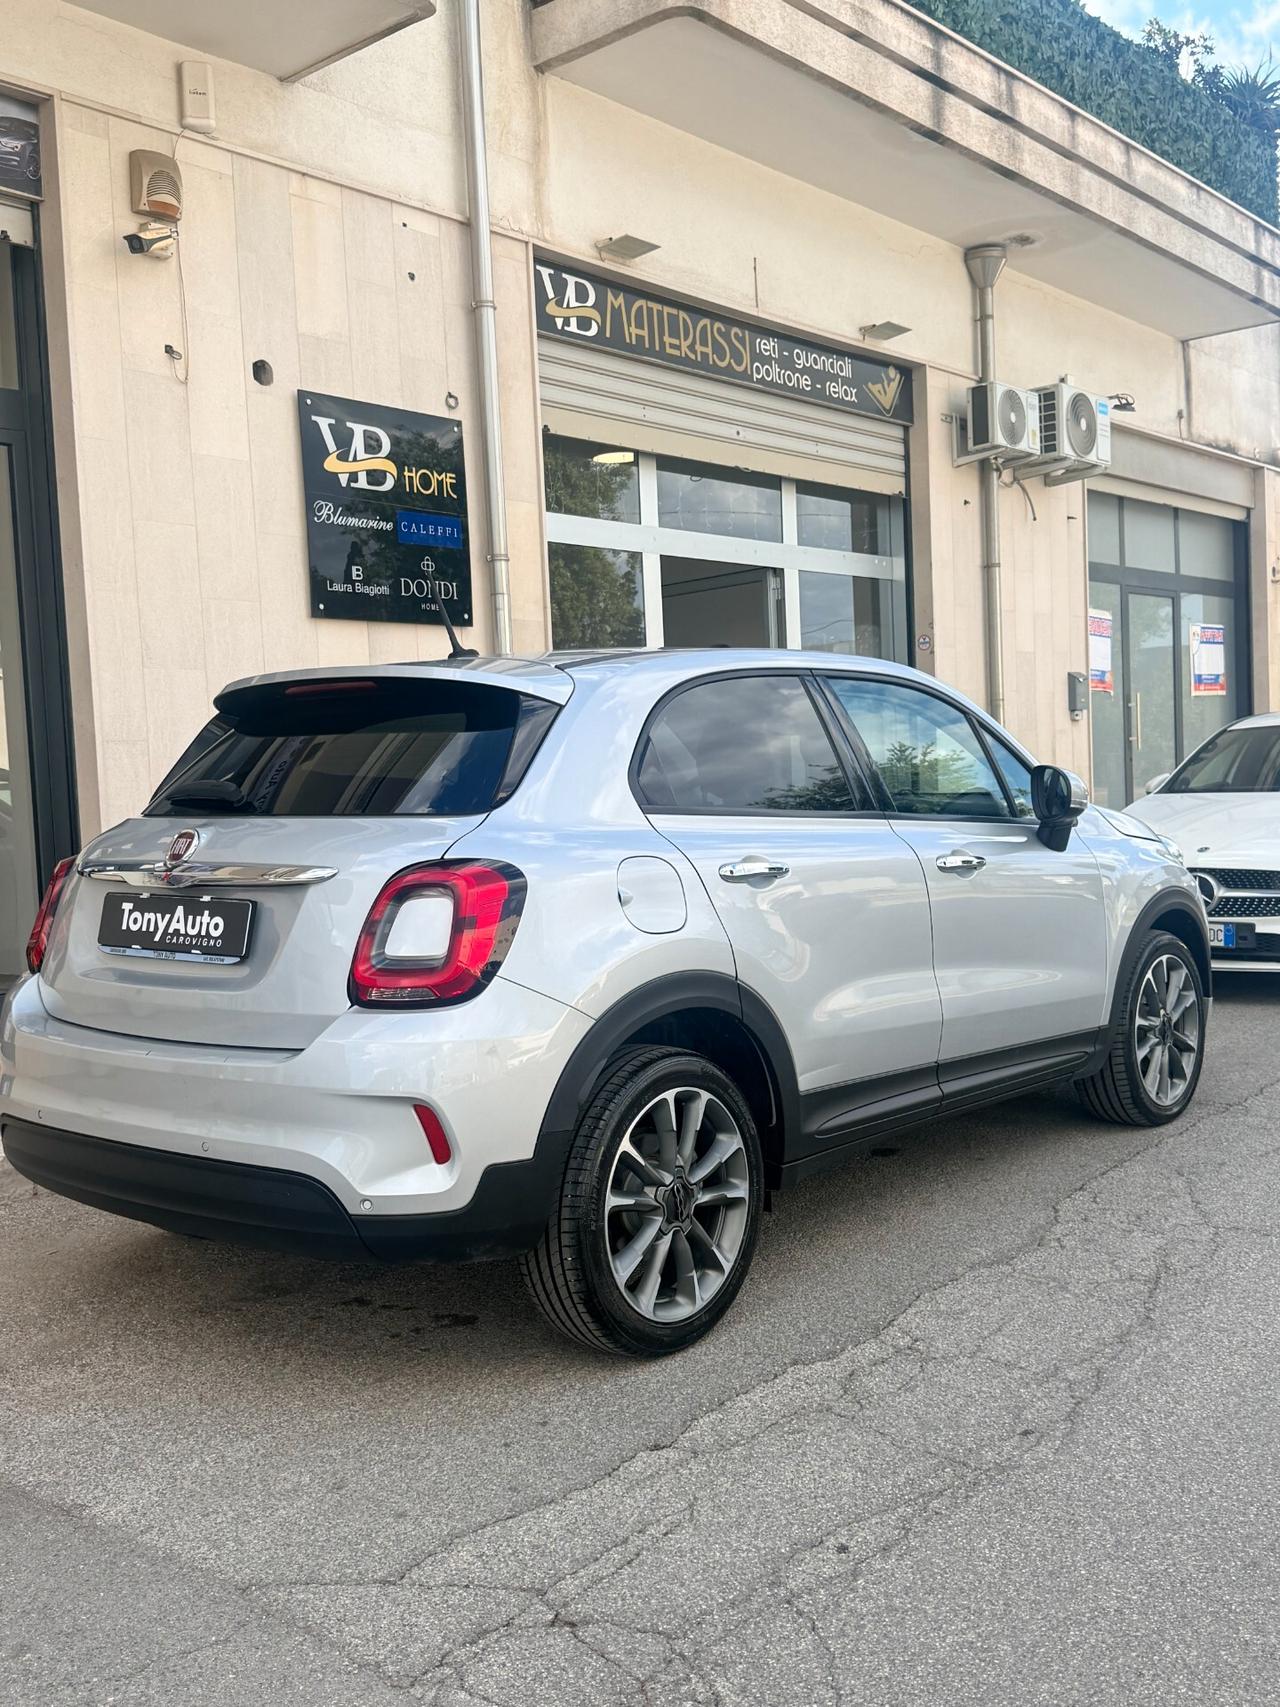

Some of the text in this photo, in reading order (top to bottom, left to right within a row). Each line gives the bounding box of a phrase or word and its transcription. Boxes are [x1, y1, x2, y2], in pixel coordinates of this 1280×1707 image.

[536, 265, 750, 374] VB MATERASSI
[756, 337, 778, 359] reti
[793, 349, 852, 379] guanciali
[753, 360, 812, 391] poltrone
[826, 378, 858, 403] relax
[311, 415, 458, 499] VB HOME
[313, 500, 394, 531] Blumarine
[401, 521, 458, 538] CALEFFI
[327, 580, 390, 597] Laura Biagiotti
[170, 838, 192, 855] FIAT
[121, 902, 224, 941] TonyAuto
[165, 935, 222, 948] CAROVIGNO
